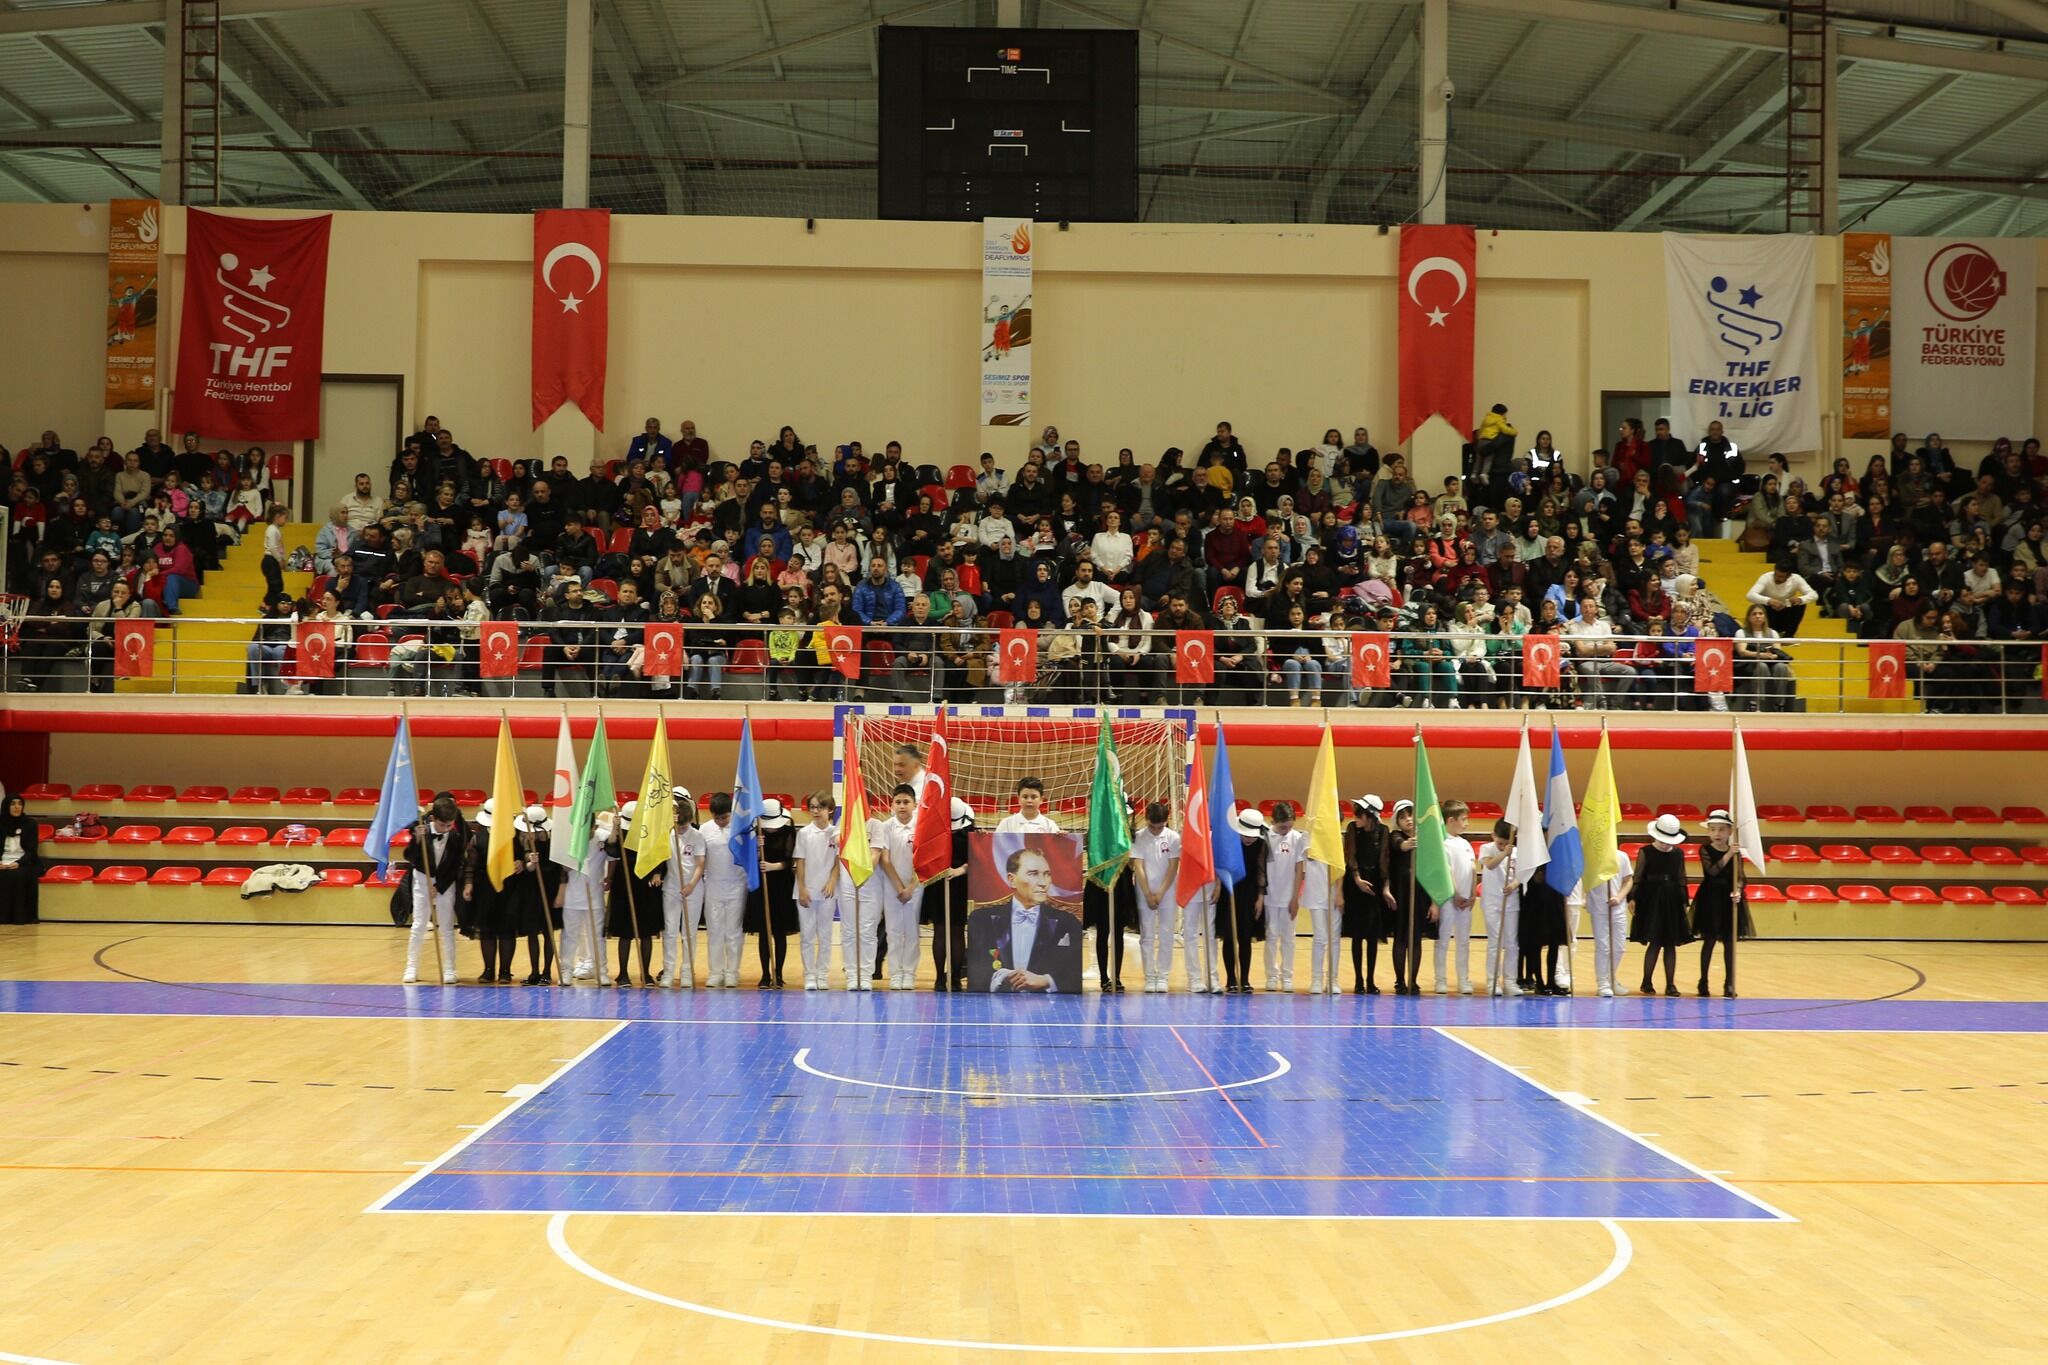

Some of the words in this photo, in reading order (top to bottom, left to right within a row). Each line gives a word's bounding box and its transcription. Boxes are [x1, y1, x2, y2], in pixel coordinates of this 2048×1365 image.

[1000, 65, 1017, 74] TIME
[1844, 276, 1889, 284] DEAFLYMPICS
[1922, 323, 2006, 344] TÜRKİYE
[1922, 343, 2006, 356] BASKETBOL
[209, 342, 293, 377] THF
[1921, 355, 2005, 367] FEDERASYONU
[1726, 360, 1771, 377] THF
[206, 378, 243, 392] Türkiye
[244, 382, 293, 392] Hentbol
[1688, 376, 1802, 397] ERKEKLER
[204, 389, 275, 404] Federasyonu
[1719, 402, 1733, 417] 1.
[1739, 397, 1774, 418] LİG
